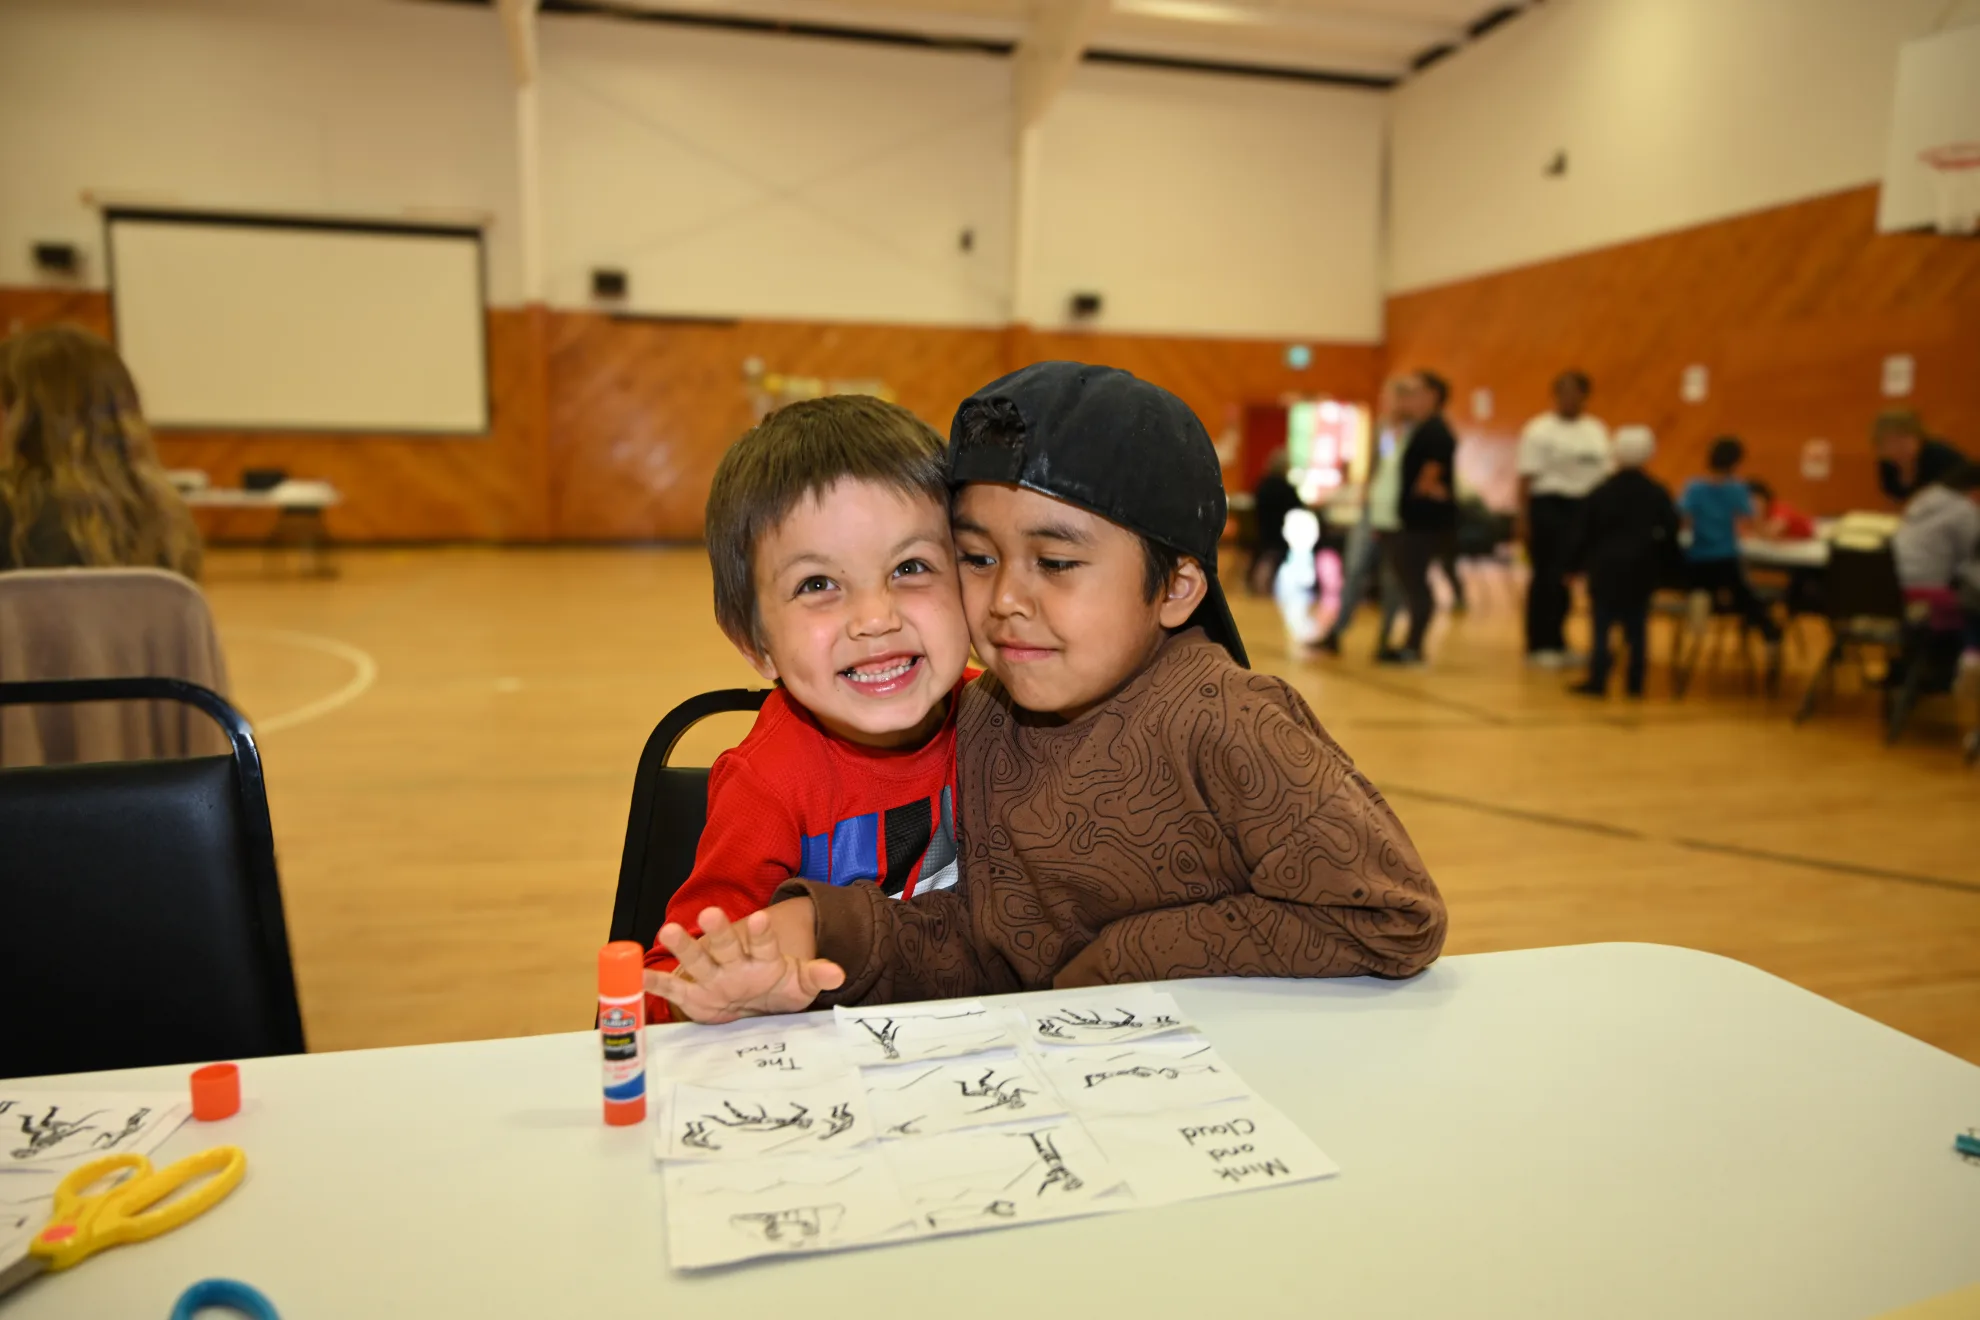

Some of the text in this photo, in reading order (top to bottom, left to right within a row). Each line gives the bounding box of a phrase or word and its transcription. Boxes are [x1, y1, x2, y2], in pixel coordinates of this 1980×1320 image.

[1178, 1118, 1254, 1145] Cloud
[1207, 1143, 1254, 1161] and
[1213, 1158, 1289, 1182] Mink
